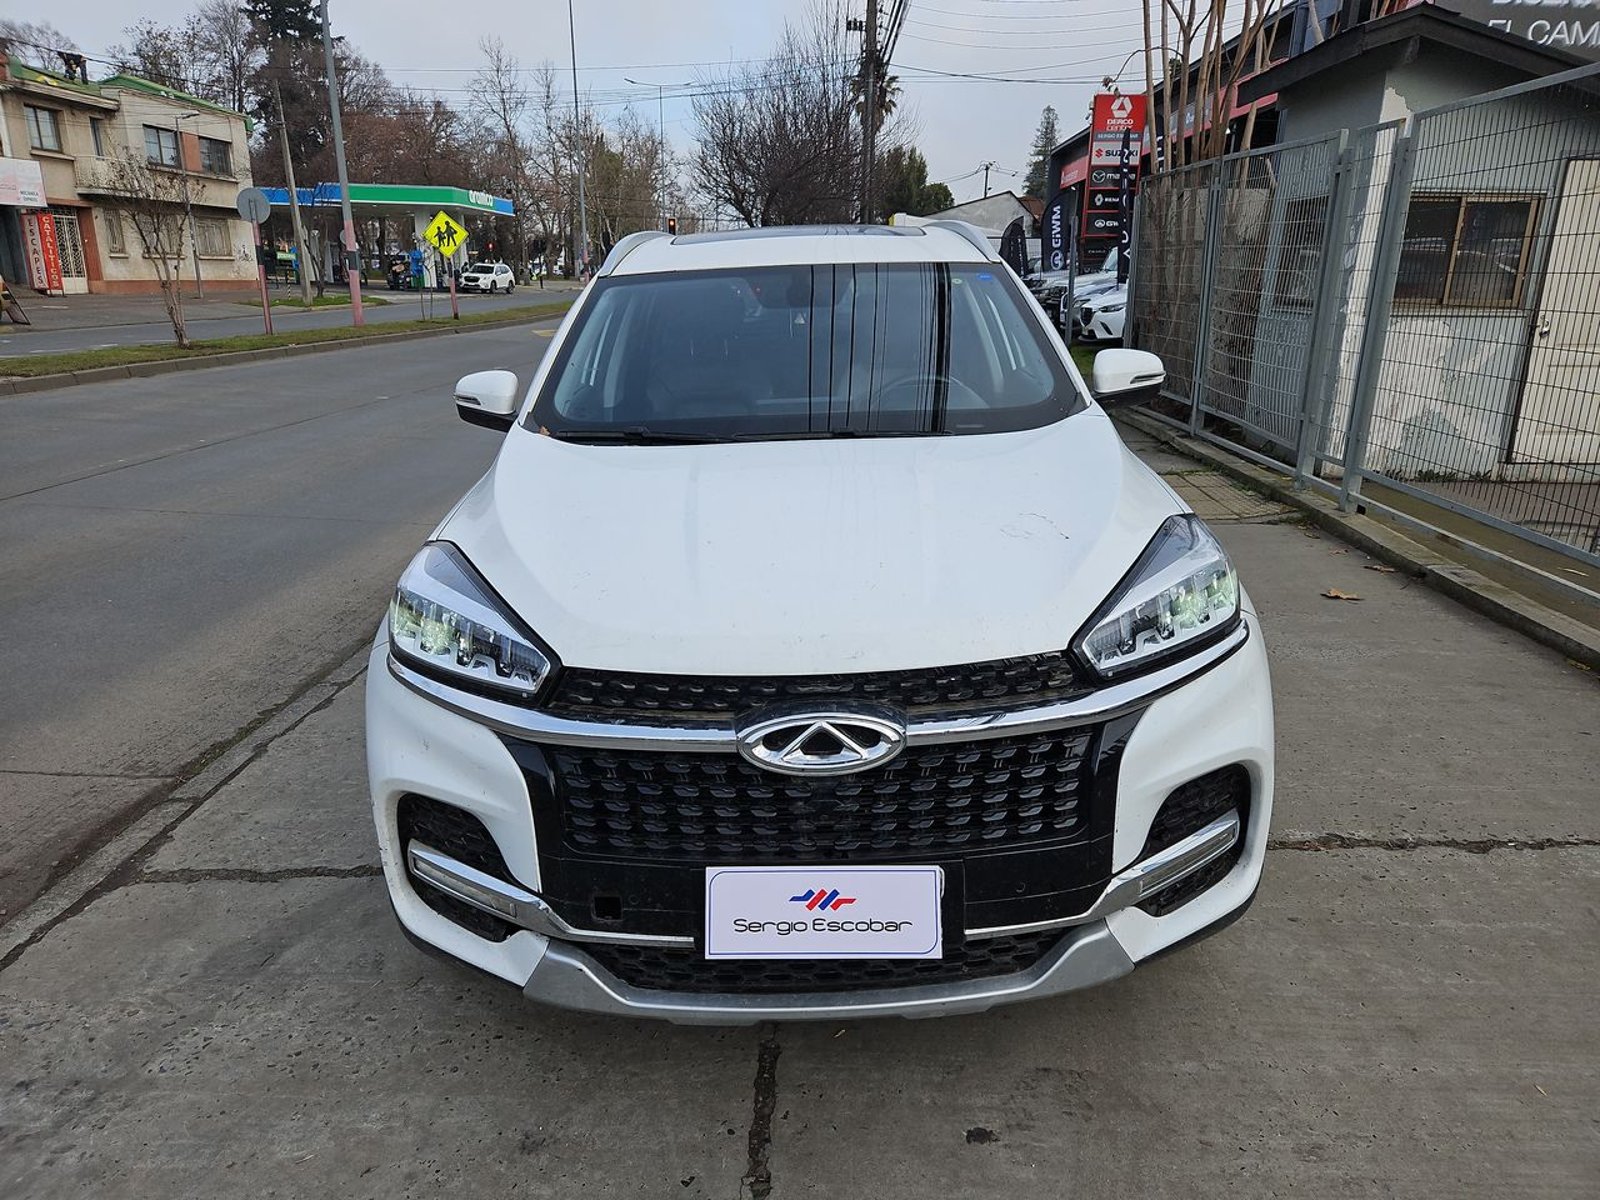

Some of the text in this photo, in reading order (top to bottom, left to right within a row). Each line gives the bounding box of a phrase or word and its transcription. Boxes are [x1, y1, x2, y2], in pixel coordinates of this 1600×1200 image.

[27, 218, 43, 285] ESCAPES
[733, 917, 912, 936] Sergio Escobar
